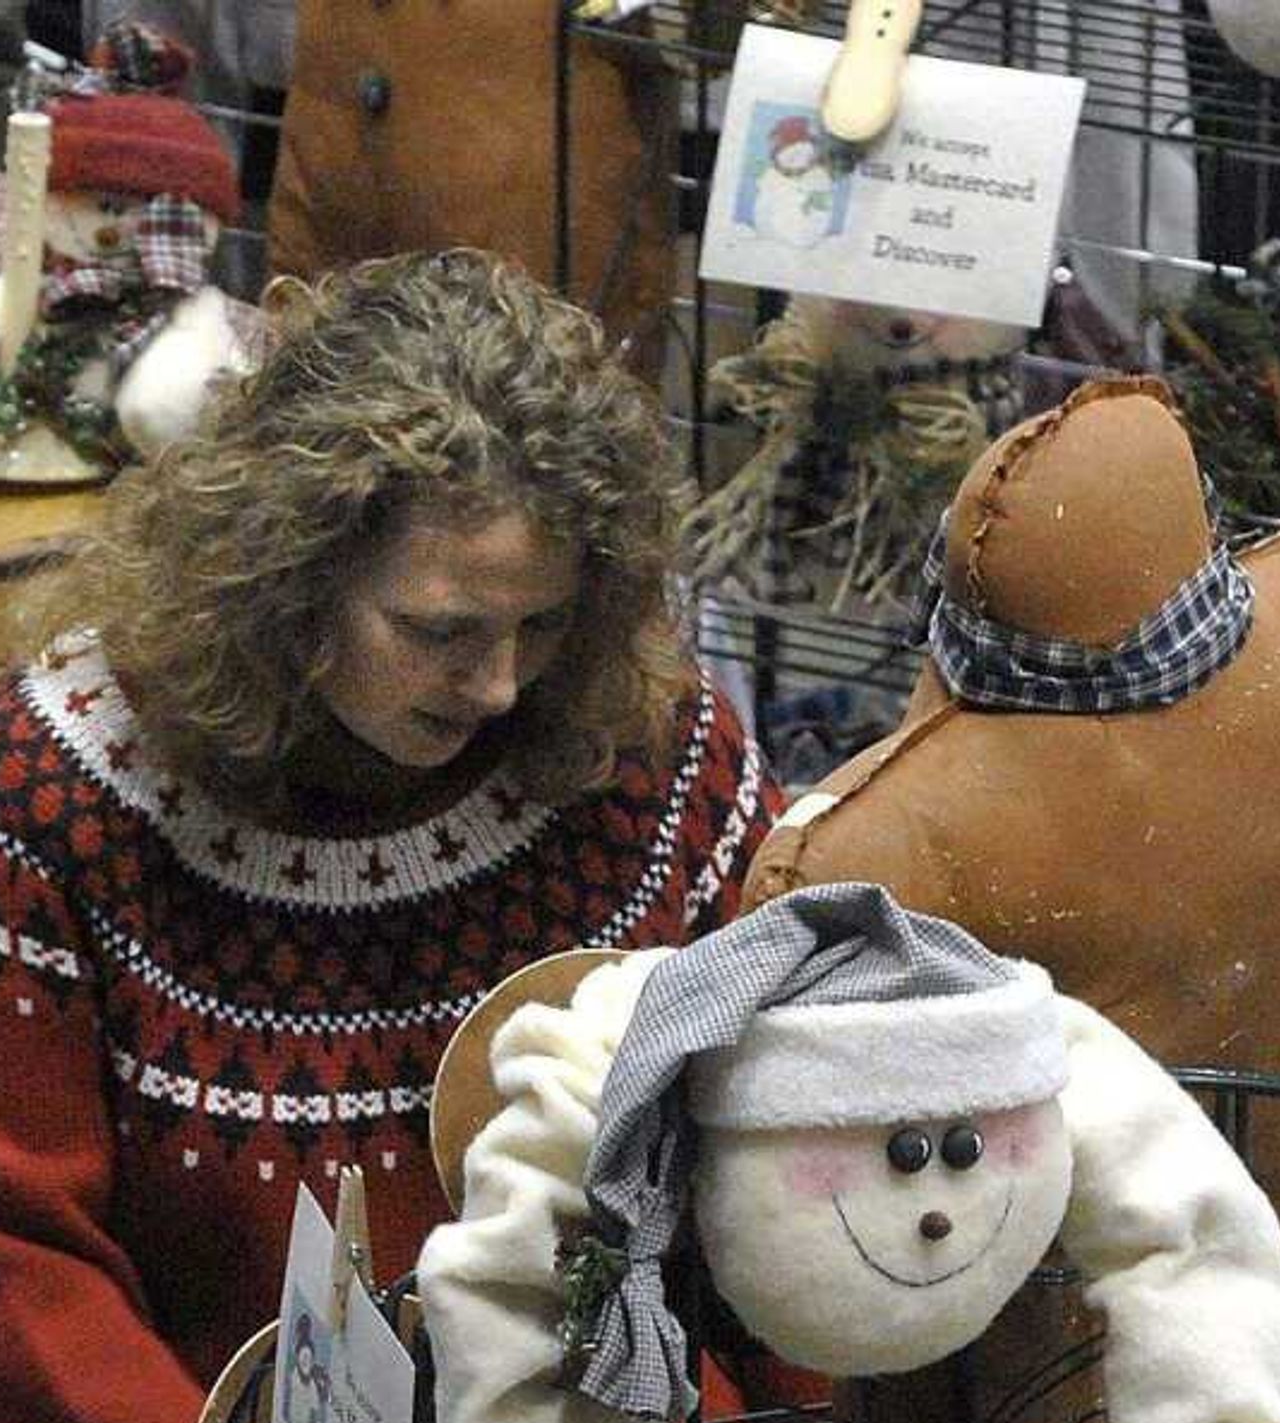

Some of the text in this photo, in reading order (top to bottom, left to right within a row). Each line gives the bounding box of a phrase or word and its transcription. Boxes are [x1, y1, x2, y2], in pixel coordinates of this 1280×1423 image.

[906, 161, 1035, 202] Mastercard
[910, 206, 954, 229] and
[873, 234, 978, 270] Discover
